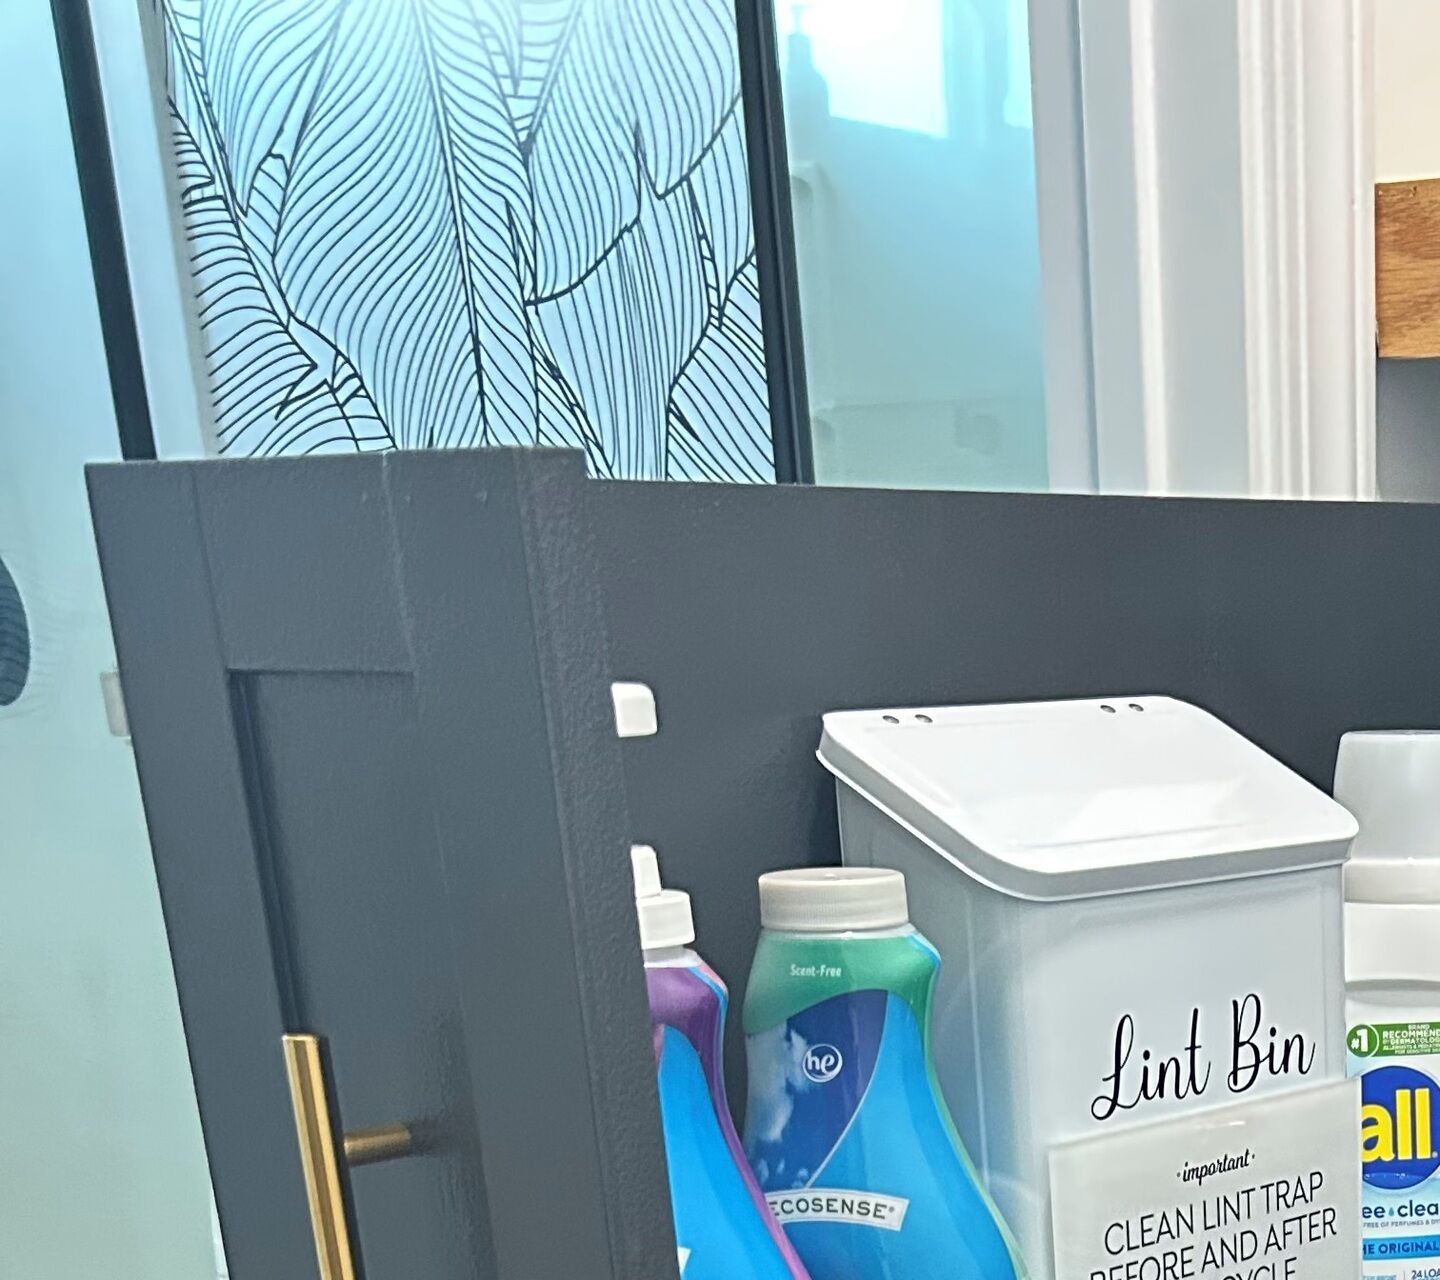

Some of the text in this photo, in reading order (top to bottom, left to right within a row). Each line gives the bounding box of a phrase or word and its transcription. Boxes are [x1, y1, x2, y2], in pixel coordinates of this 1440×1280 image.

[790, 964, 842, 977] Scent-Free
[1091, 993, 1316, 1120] Lint Bin
[1361, 1088, 1431, 1162] all
[1182, 1148, 1250, 1187] important
[1104, 1171, 1324, 1256] CLEAN LINT TRAP
[1362, 1205, 1386, 1219] ee
[1201, 1230, 1258, 1274] AND
[1264, 1207, 1337, 1255] AFTER
[1378, 1242, 1439, 1254] ORIGINAL
[1411, 1270, 1422, 1279] 24
